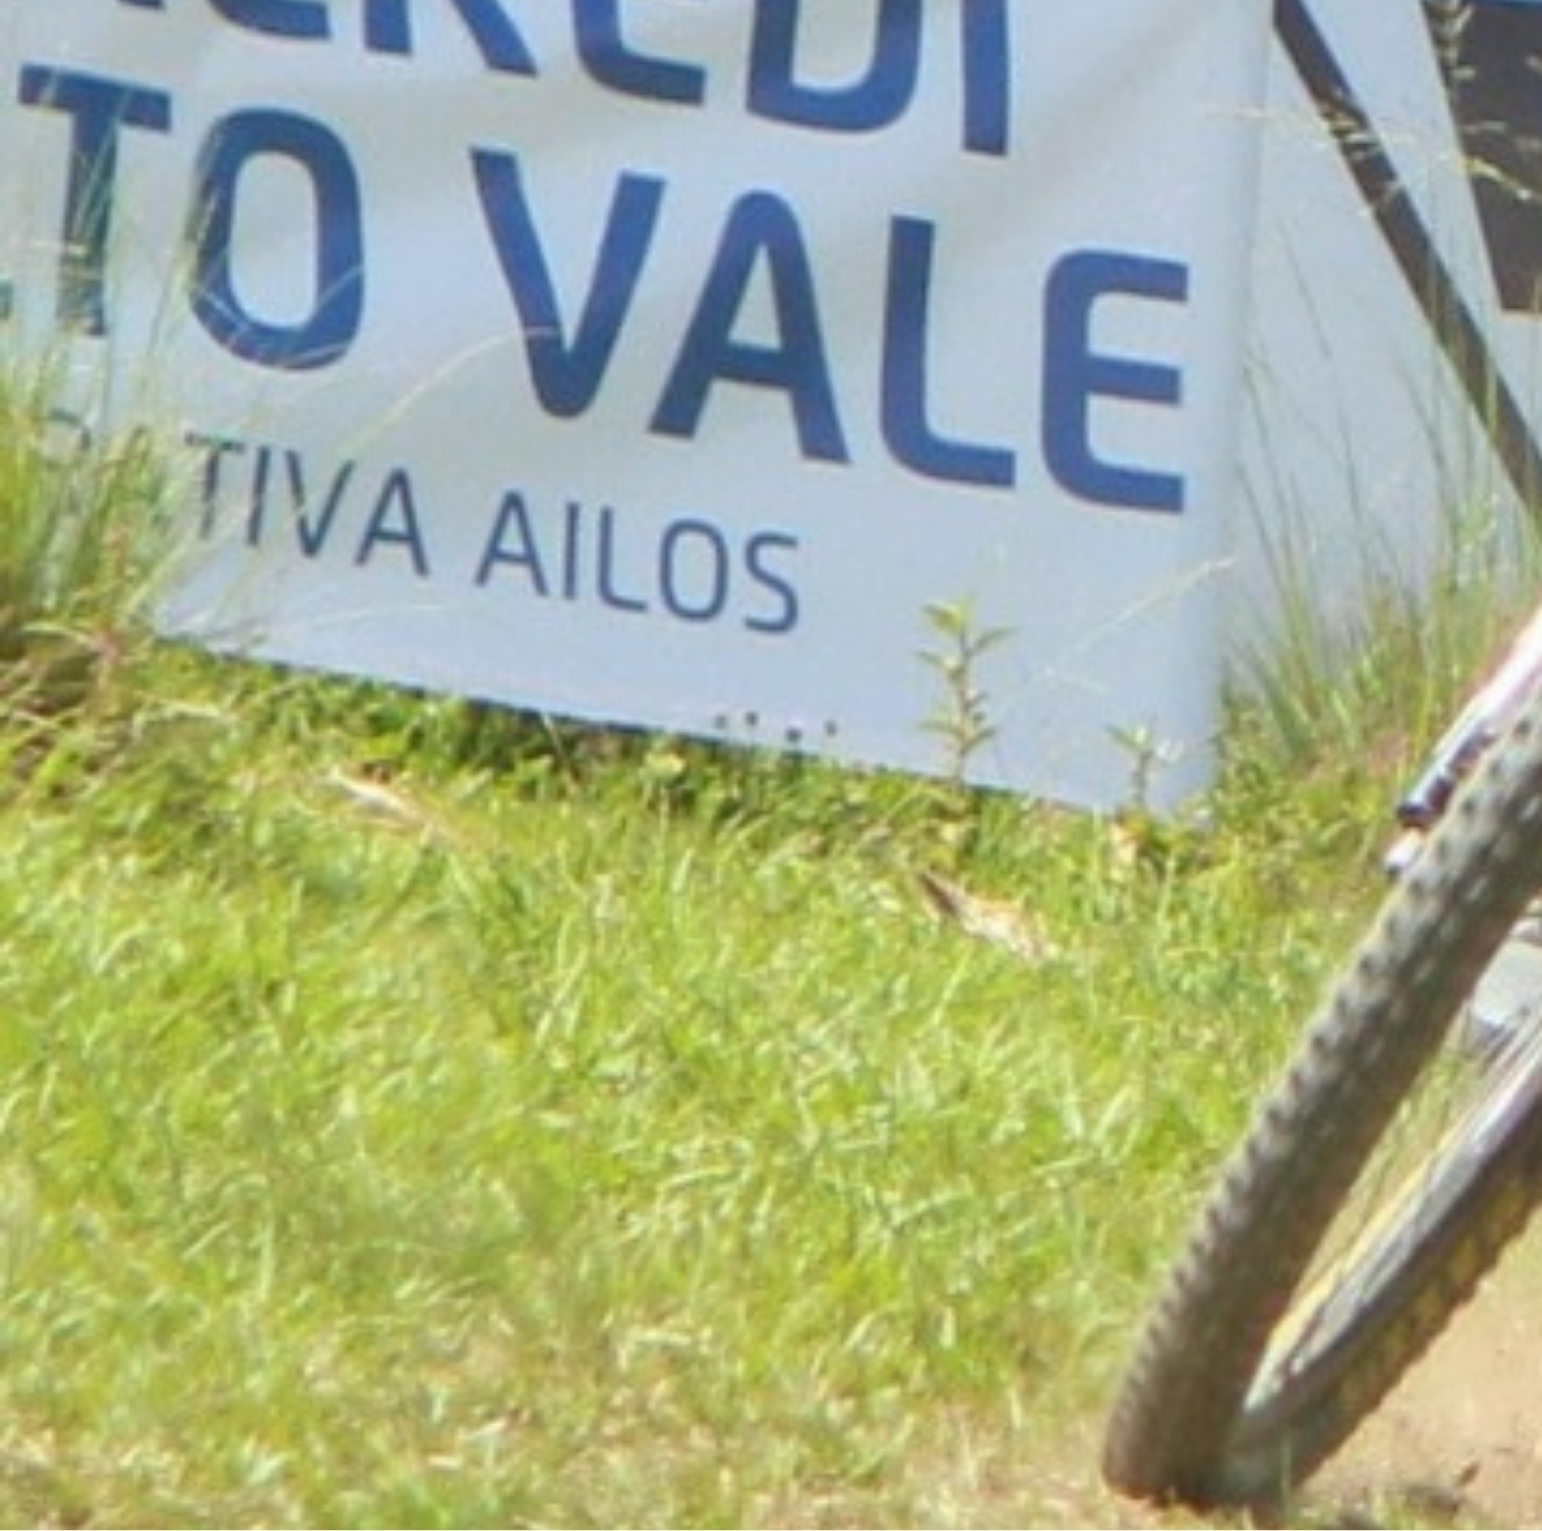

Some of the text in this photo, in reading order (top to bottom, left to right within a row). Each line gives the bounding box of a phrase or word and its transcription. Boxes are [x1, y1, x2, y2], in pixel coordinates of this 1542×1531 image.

[0, 63, 366, 370] TO
[469, 146, 1189, 515] VALE
[474, 490, 799, 634] AILOS
